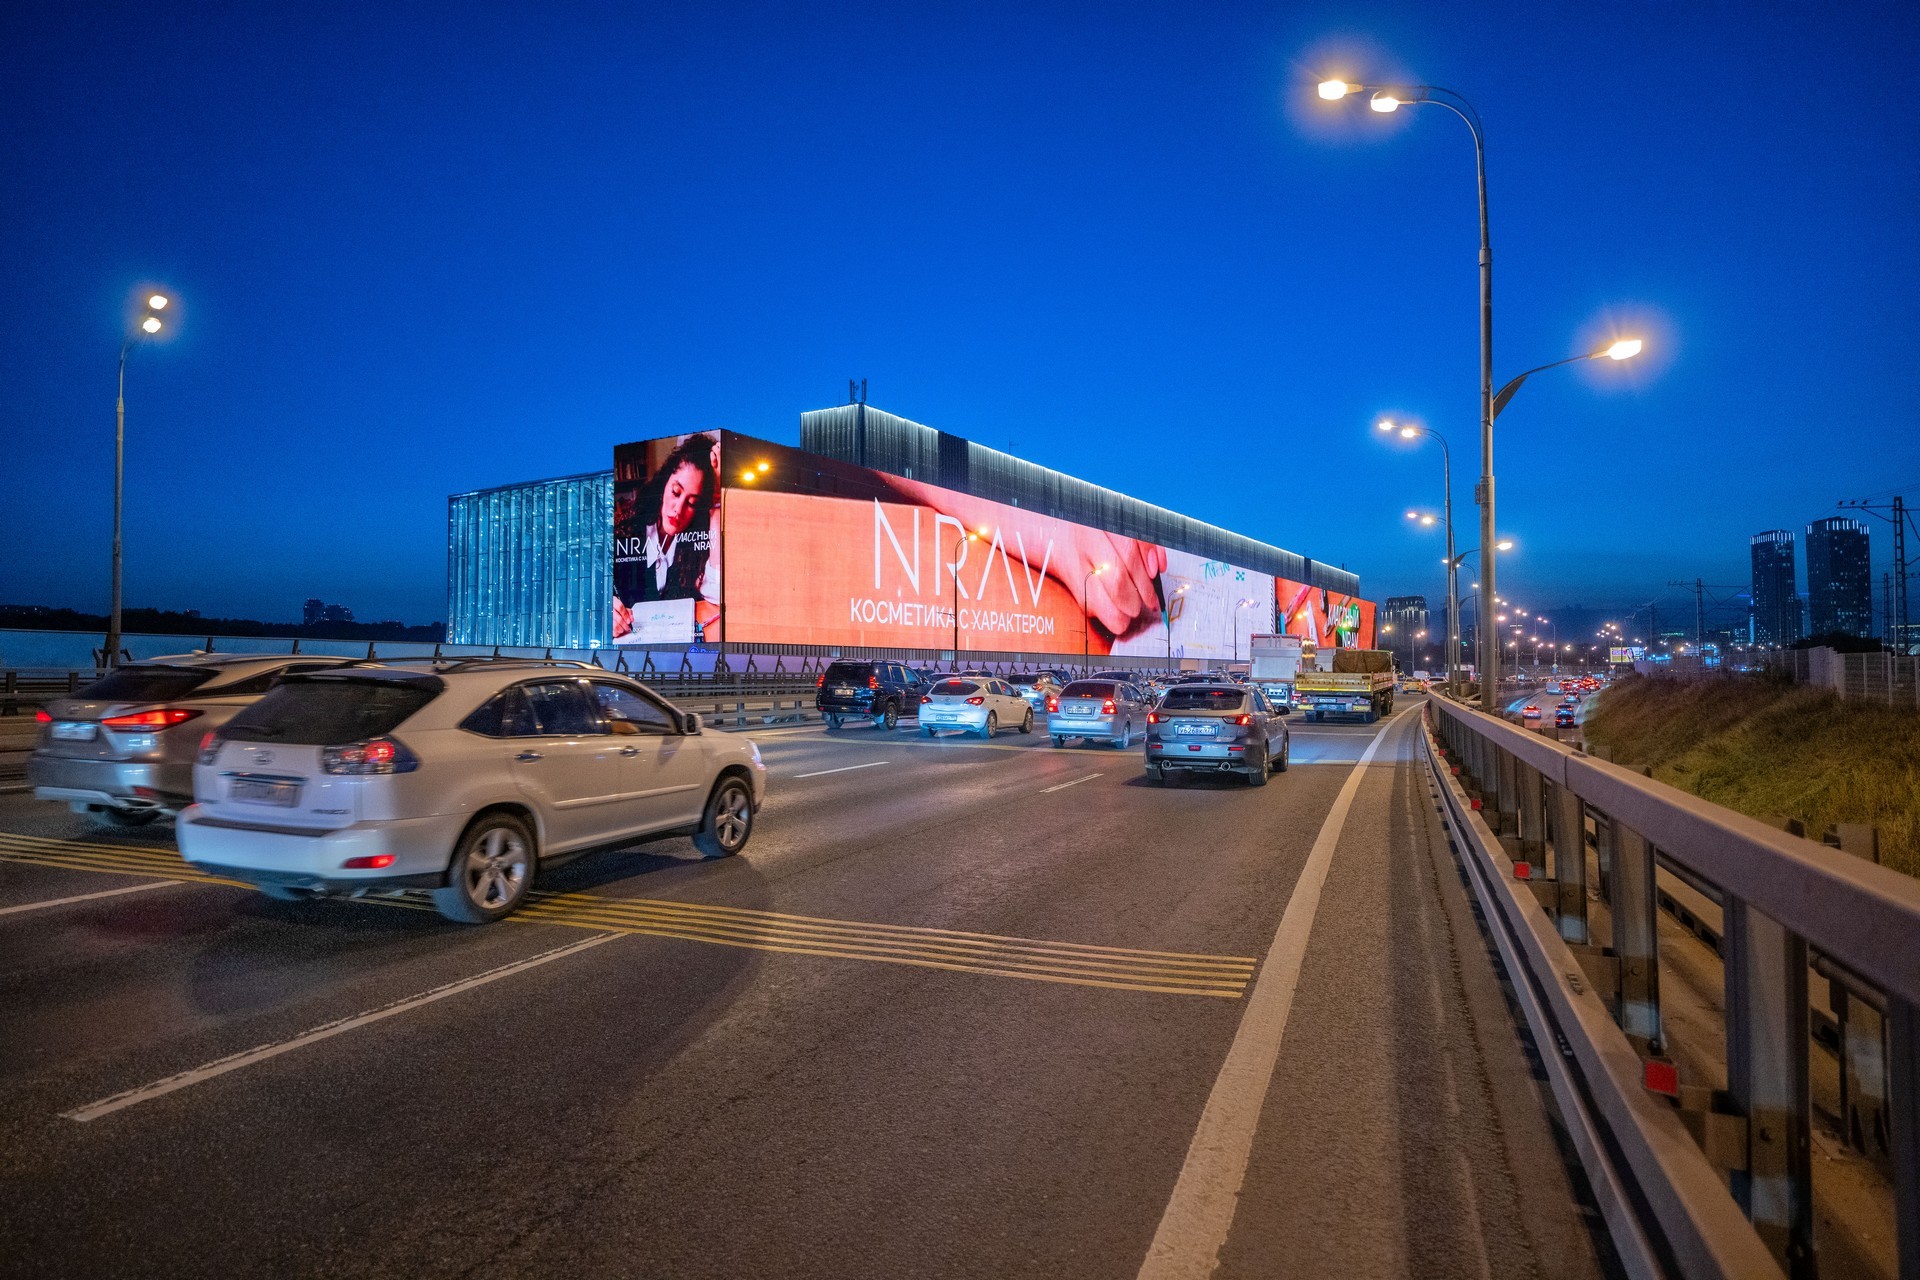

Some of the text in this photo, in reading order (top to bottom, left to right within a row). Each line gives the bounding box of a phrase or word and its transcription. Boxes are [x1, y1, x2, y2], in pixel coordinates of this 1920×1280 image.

[693, 541, 717, 551] NRAV
[874, 497, 1054, 608] NRAV
[850, 597, 1055, 635] КОСМЕТИКА С ХАРАКТЕРОМ
